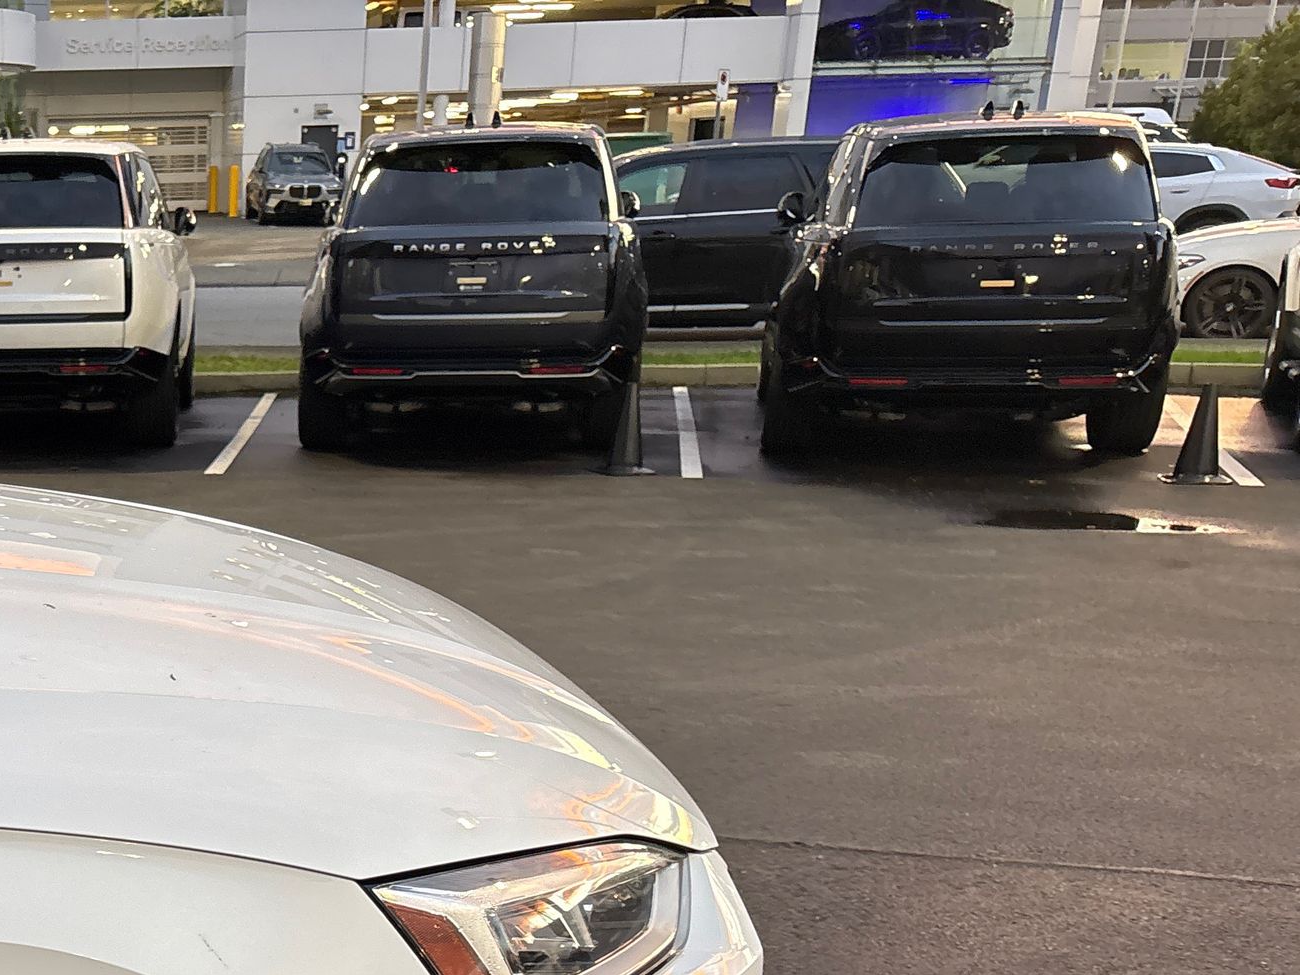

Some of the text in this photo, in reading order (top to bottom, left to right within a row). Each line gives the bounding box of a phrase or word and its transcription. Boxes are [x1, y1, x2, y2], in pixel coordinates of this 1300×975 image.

[66, 34, 231, 55] Service Reception
[393, 242, 465, 253] RANGE
